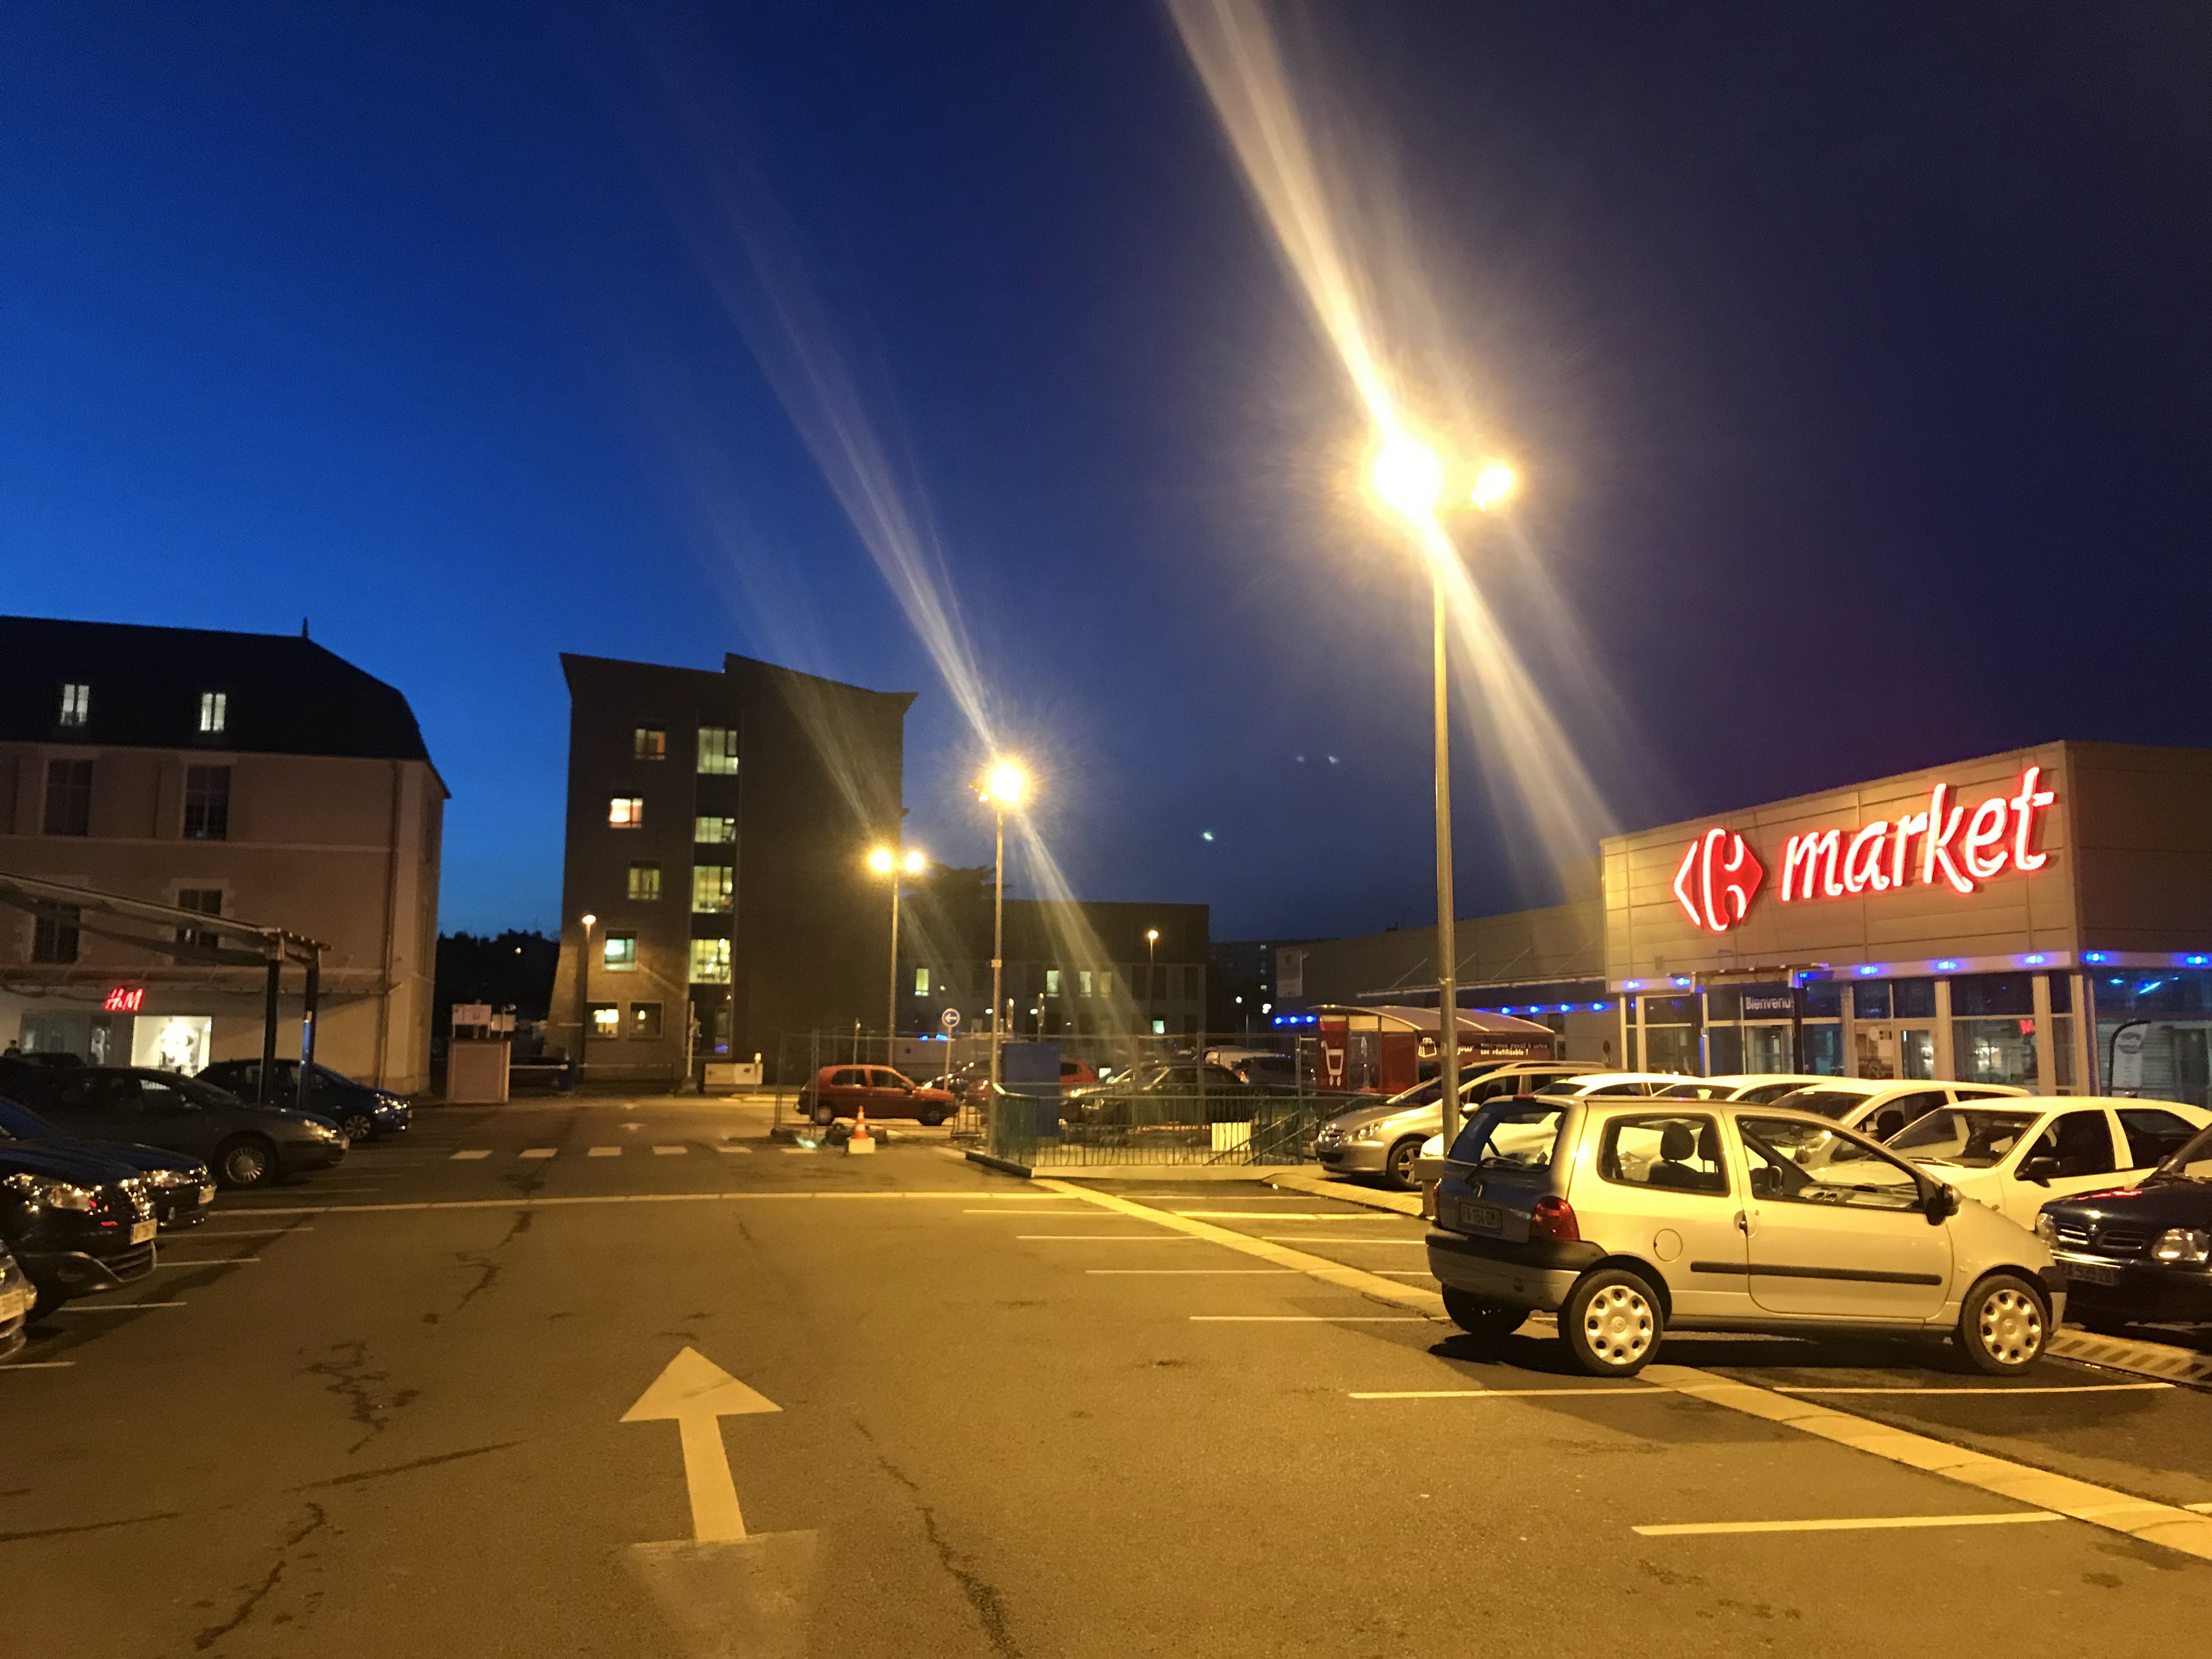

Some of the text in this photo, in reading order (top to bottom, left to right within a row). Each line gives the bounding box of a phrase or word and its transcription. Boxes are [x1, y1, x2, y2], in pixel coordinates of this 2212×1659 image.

[1781, 766, 2055, 901] market
[105, 988, 143, 1012] H&M
[1492, 1048, 1524, 1056] réutilisable
